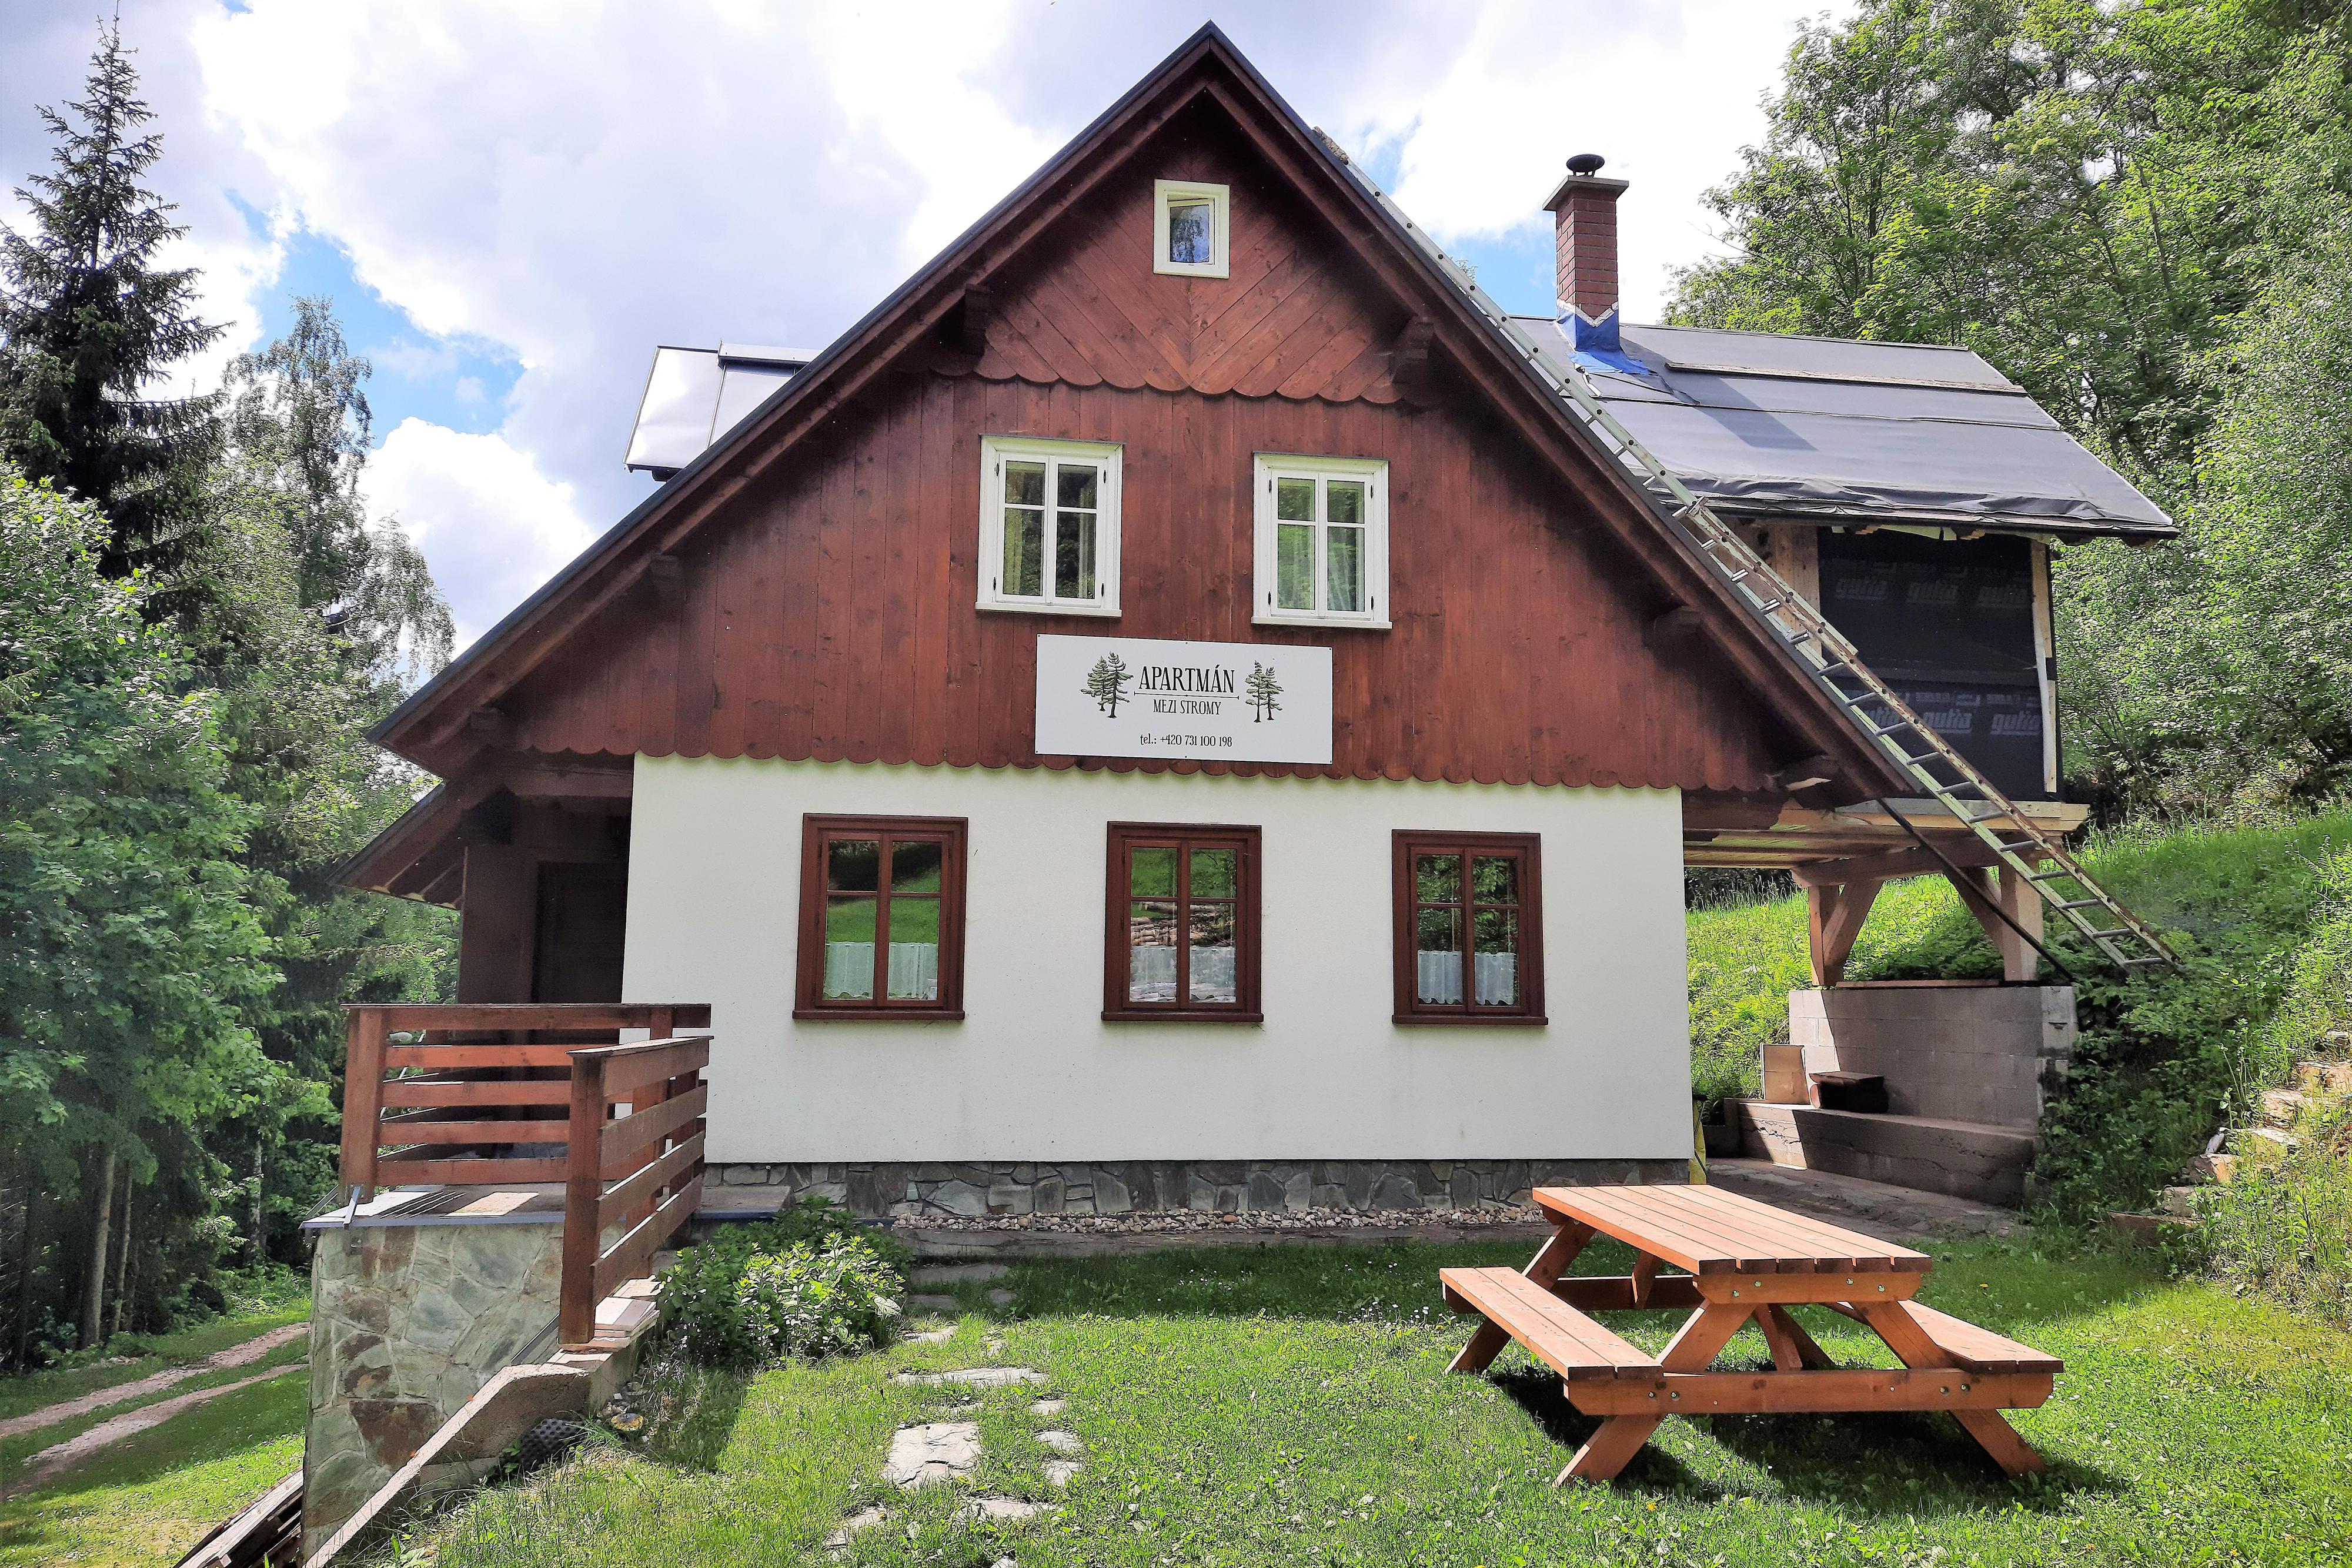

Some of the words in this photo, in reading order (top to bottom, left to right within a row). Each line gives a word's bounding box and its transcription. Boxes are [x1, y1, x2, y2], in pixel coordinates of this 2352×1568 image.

[1138, 664, 1235, 693] APARTMÁN
[1153, 699, 1176, 713] MEZI
[1180, 700, 1221, 715] STROMY
[1990, 710, 2041, 735] gutta
[1140, 733, 1157, 745] tel.:
[1160, 734, 1182, 745] +420
[1185, 735, 1197, 745] 731
[1200, 735, 1216, 746] 100
[1219, 736, 1232, 747] 198
